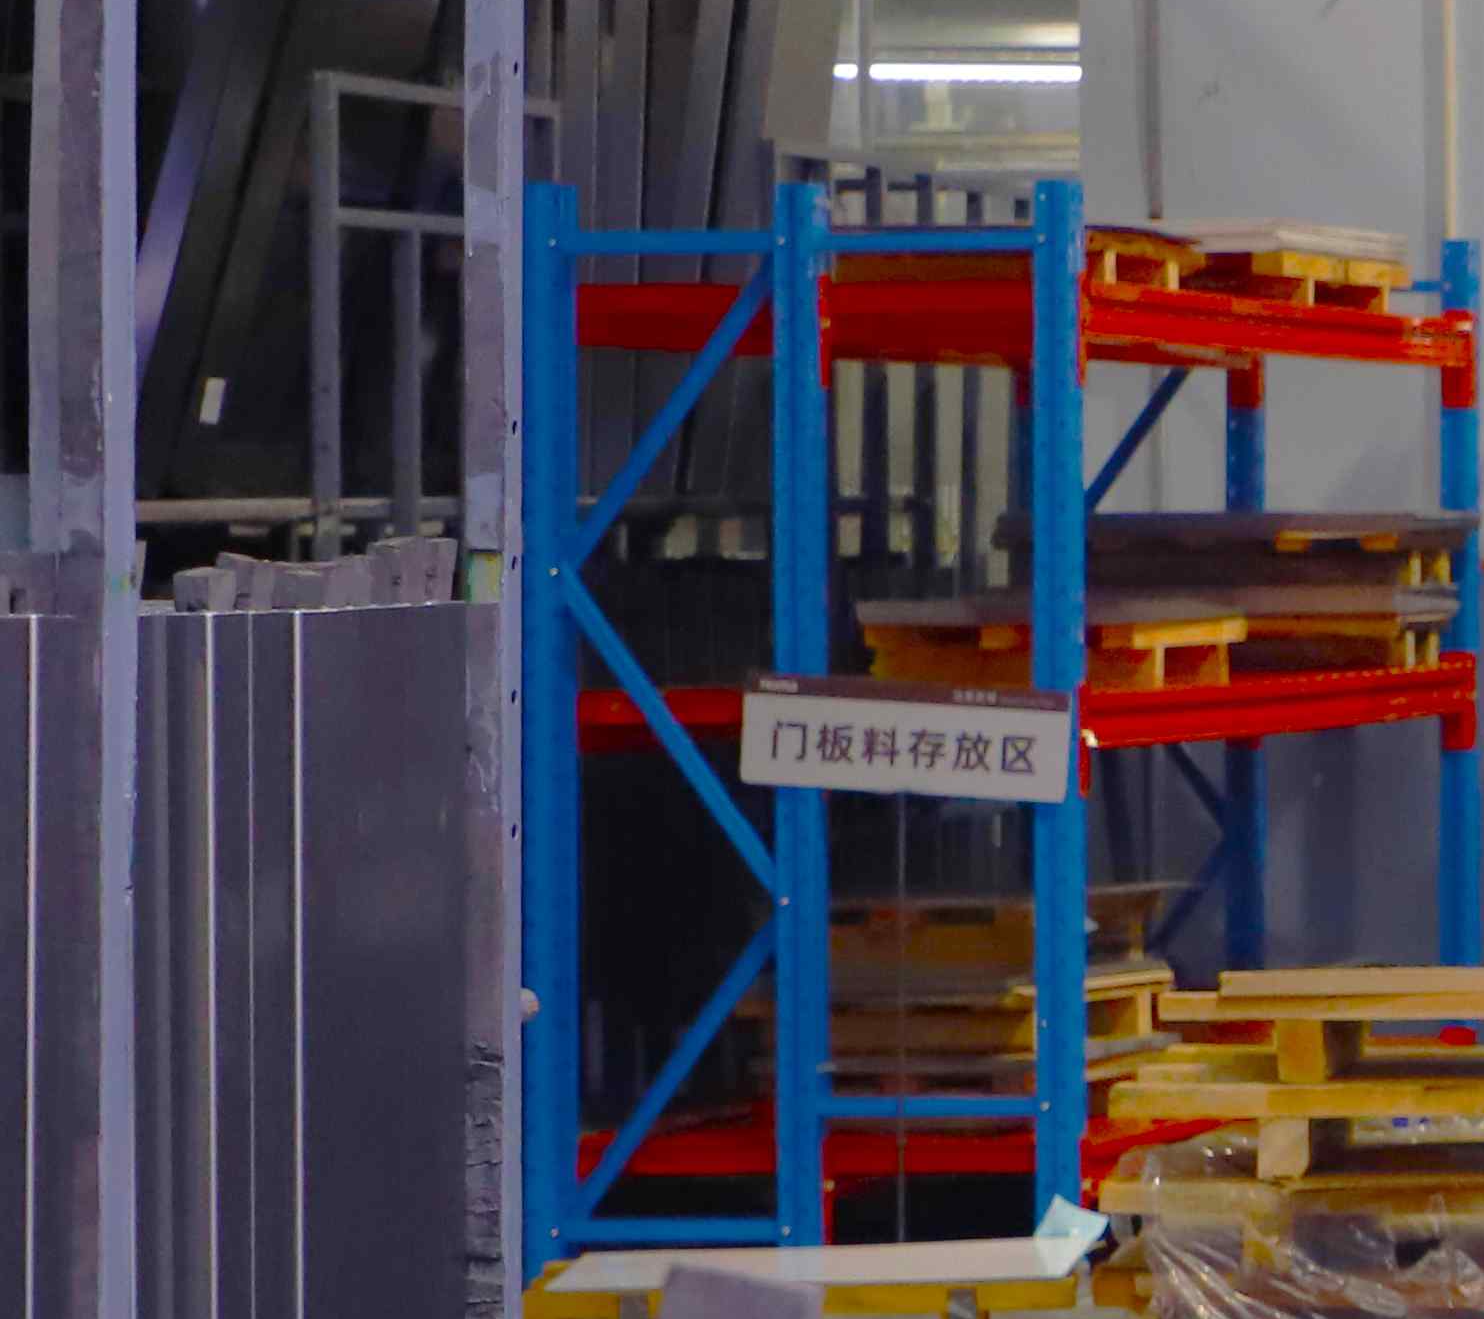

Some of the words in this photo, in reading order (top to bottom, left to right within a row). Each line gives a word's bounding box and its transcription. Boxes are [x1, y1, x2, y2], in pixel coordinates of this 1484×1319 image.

[771, 720, 1036, 774] 门板料存放区
